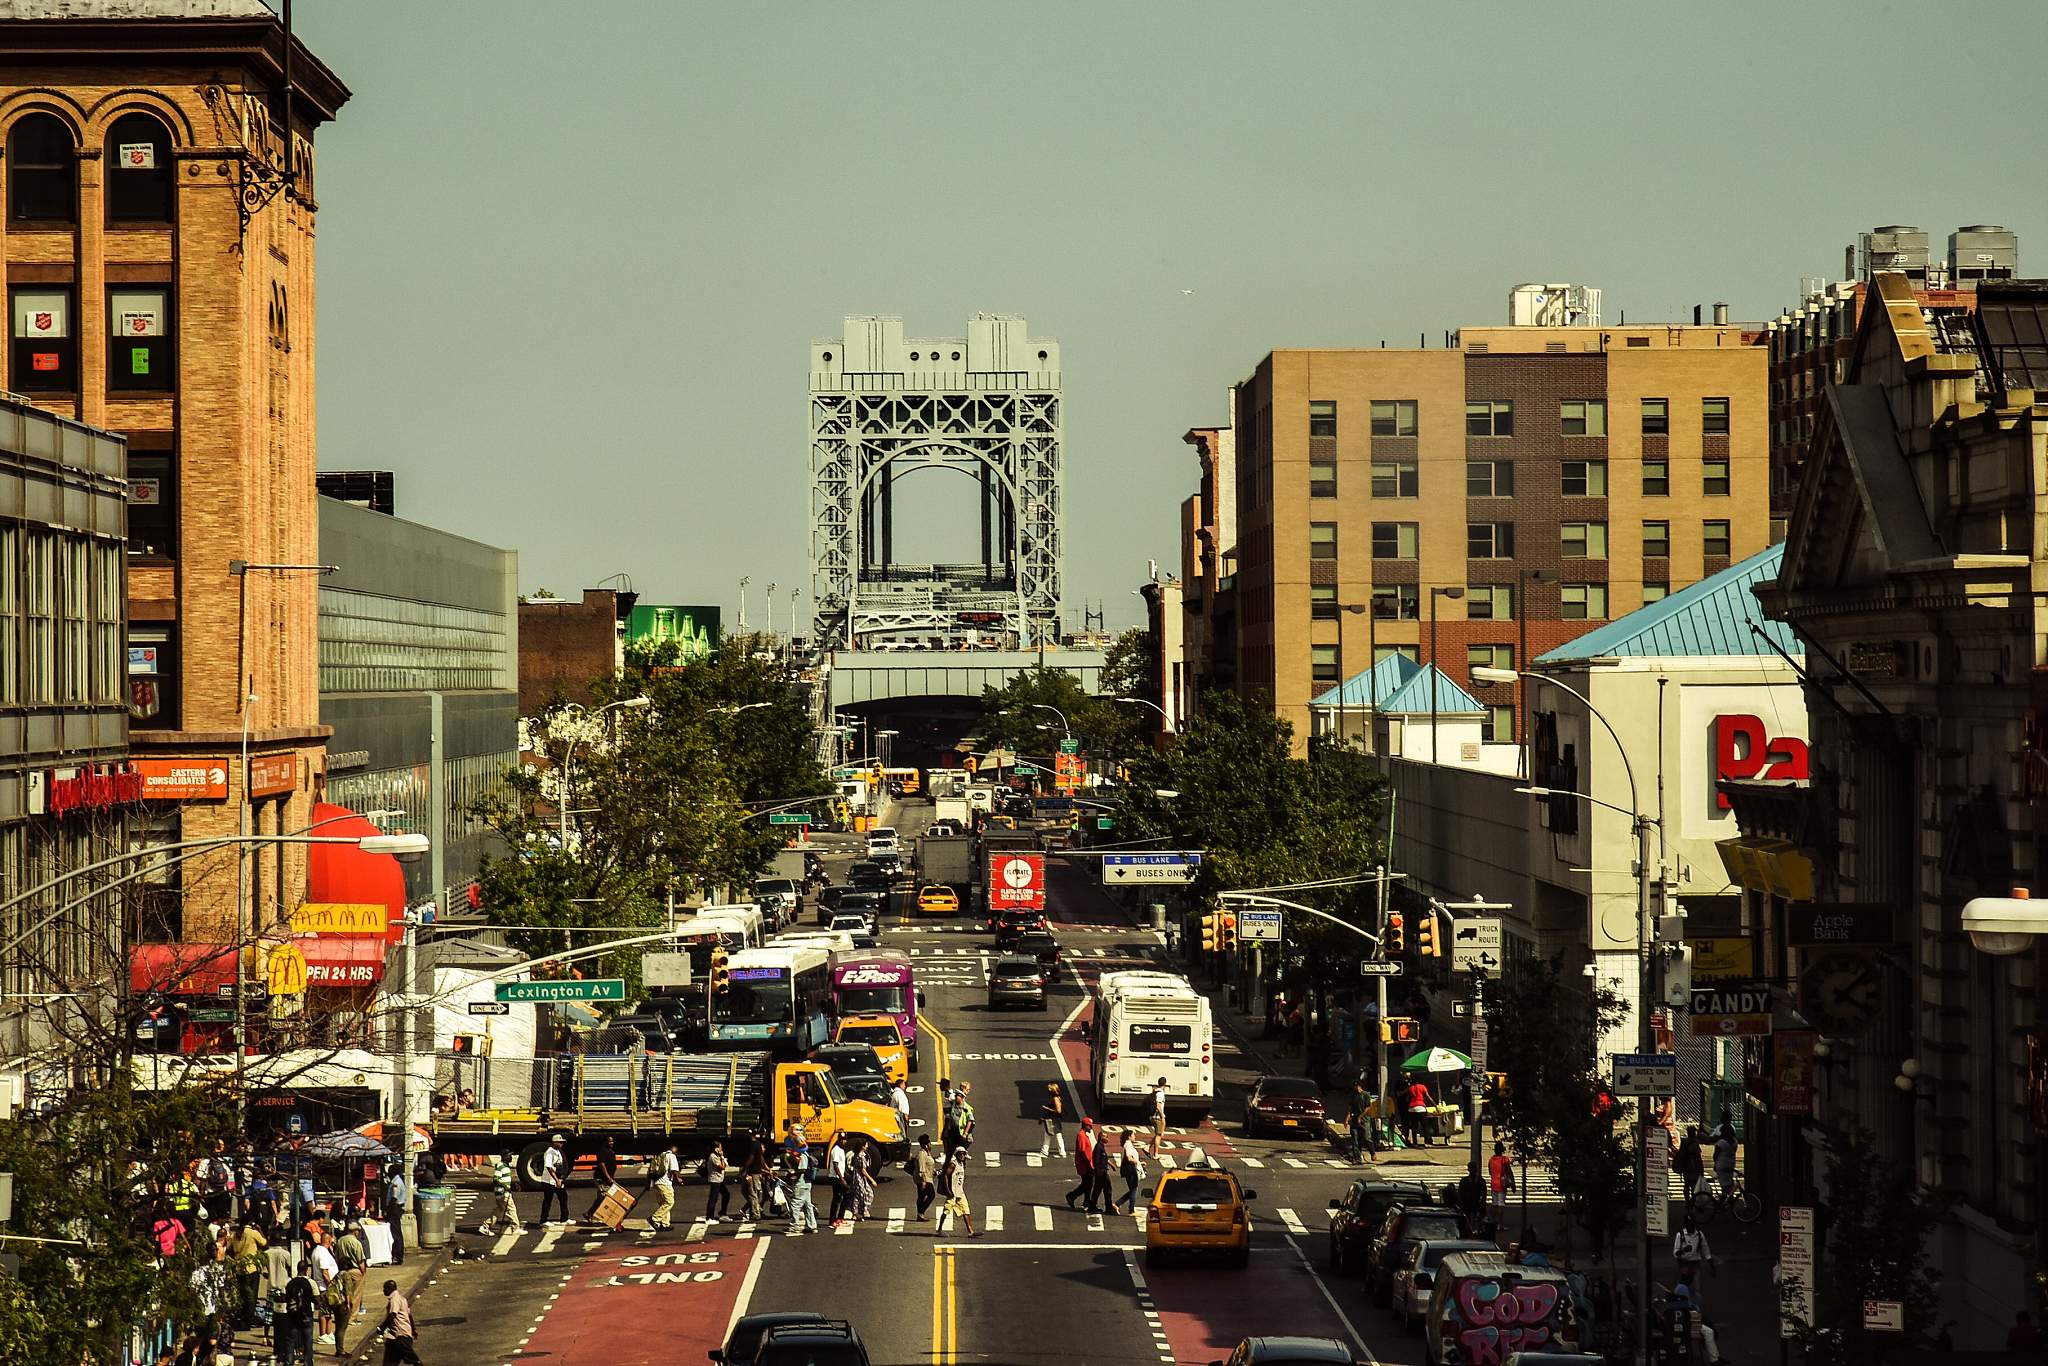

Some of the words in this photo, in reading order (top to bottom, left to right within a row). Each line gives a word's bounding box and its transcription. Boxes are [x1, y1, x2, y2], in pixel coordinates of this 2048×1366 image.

[171, 768, 206, 777] EASTERN
[147, 777, 206, 785] CONSOLIDATED
[1136, 869, 1164, 877] BUSES
[1166, 869, 1190, 877] ONL
[1812, 914, 1855, 929] Apple
[1478, 926, 1499, 934] TRUCK
[1813, 927, 1849, 940] Bank
[1478, 936, 1499, 944] ROUTE
[306, 966, 330, 980] PEN
[331, 966, 351, 980] 24
[349, 966, 374, 980] HRS
[841, 970, 902, 983] E-ZPass
[507, 986, 584, 1000] Lexington
[591, 985, 610, 997] Av
[1693, 992, 1769, 1014] CANDY
[1648, 1057, 1672, 1065] LANE
[1635, 1068, 1654, 1076] BUSES
[1655, 1068, 1671, 1076] ONLY
[262, 1097, 296, 1106] SERVICE
[621, 1252, 720, 1267] BUS
[606, 1271, 723, 1288] ONLY
